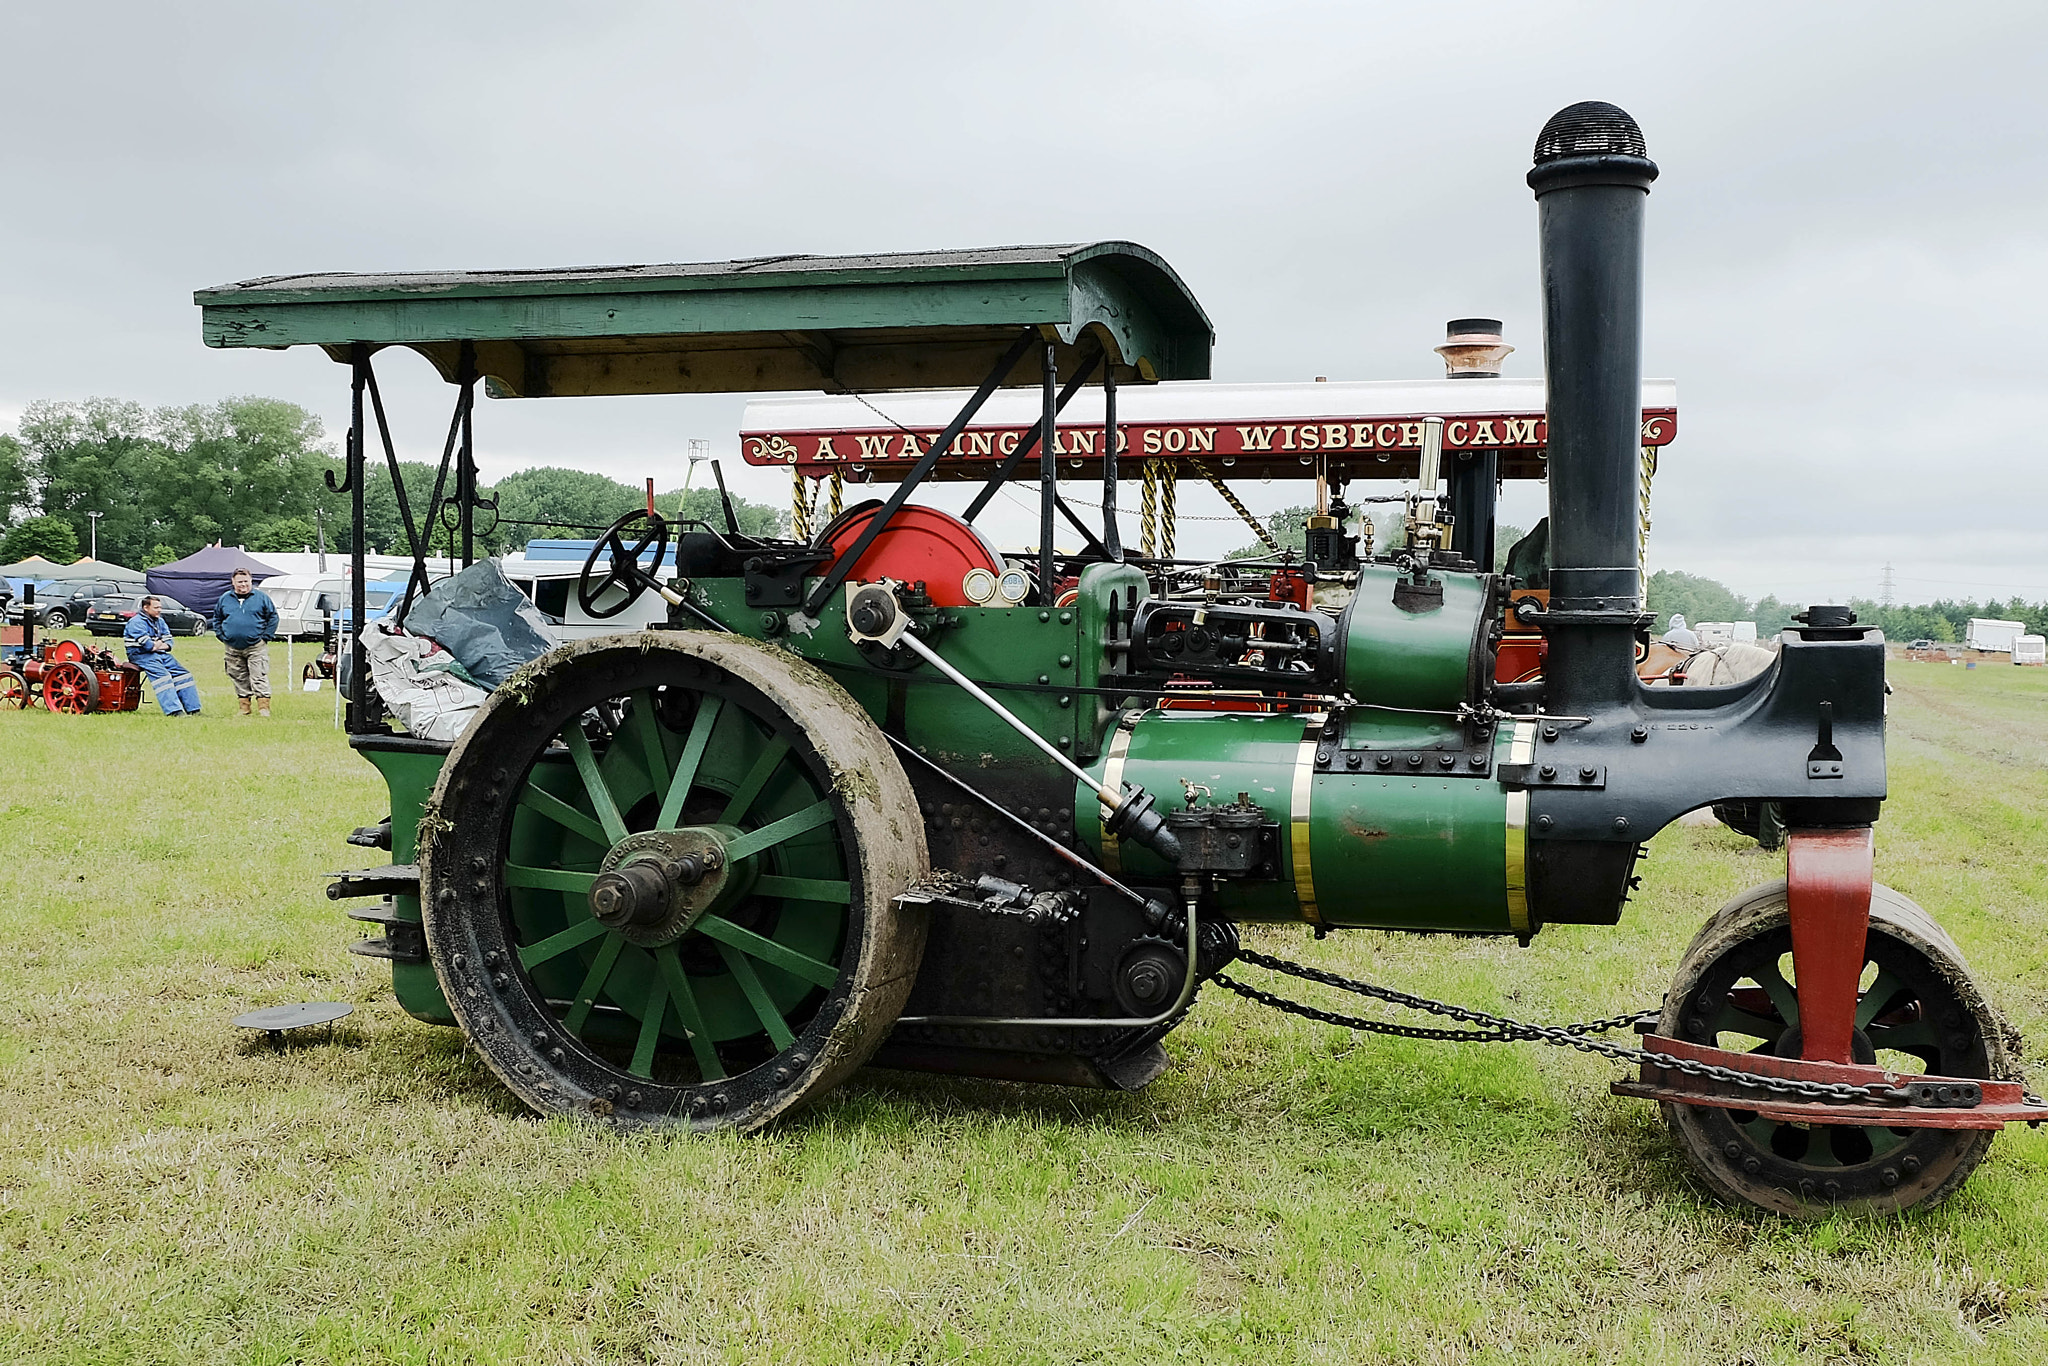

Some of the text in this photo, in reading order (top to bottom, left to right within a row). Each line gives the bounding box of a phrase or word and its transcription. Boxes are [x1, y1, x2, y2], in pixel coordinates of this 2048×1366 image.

[812, 438, 847, 460] A.
[1143, 427, 1217, 453] SON
[1236, 423, 1425, 450] WISBECH
[1448, 420, 1547, 445] CAM
[605, 837, 672, 871] ROCHESTER
